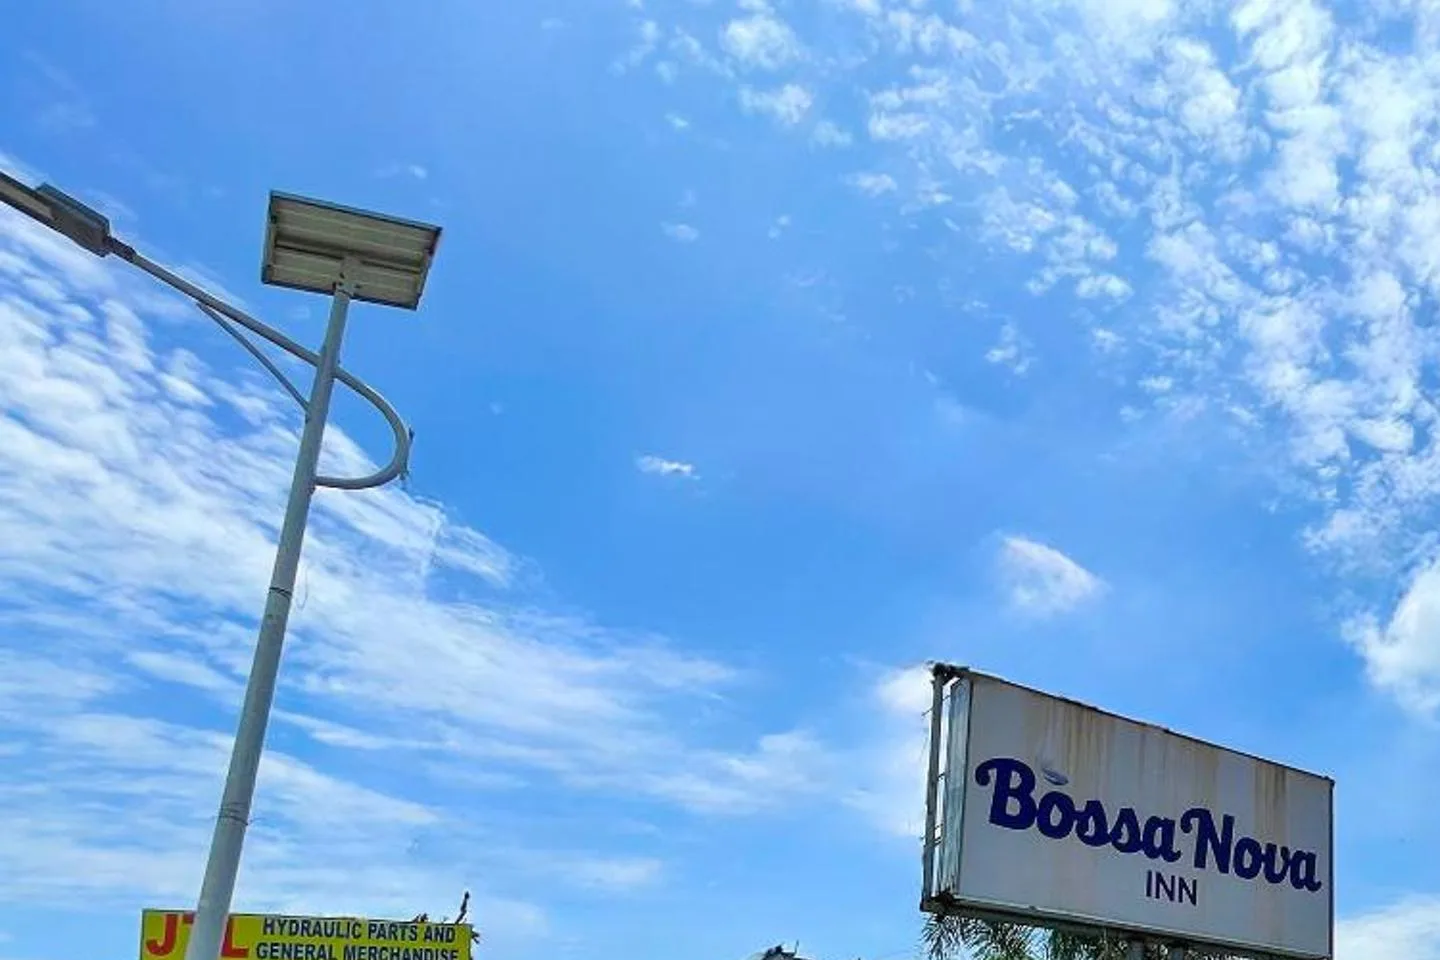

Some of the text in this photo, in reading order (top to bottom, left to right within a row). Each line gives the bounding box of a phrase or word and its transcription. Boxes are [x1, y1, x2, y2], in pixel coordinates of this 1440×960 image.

[975, 757, 1322, 892] Bossa Nova
[1145, 870, 1198, 906] INN
[262, 917, 456, 944] HYDRAULIC PARTS AND
